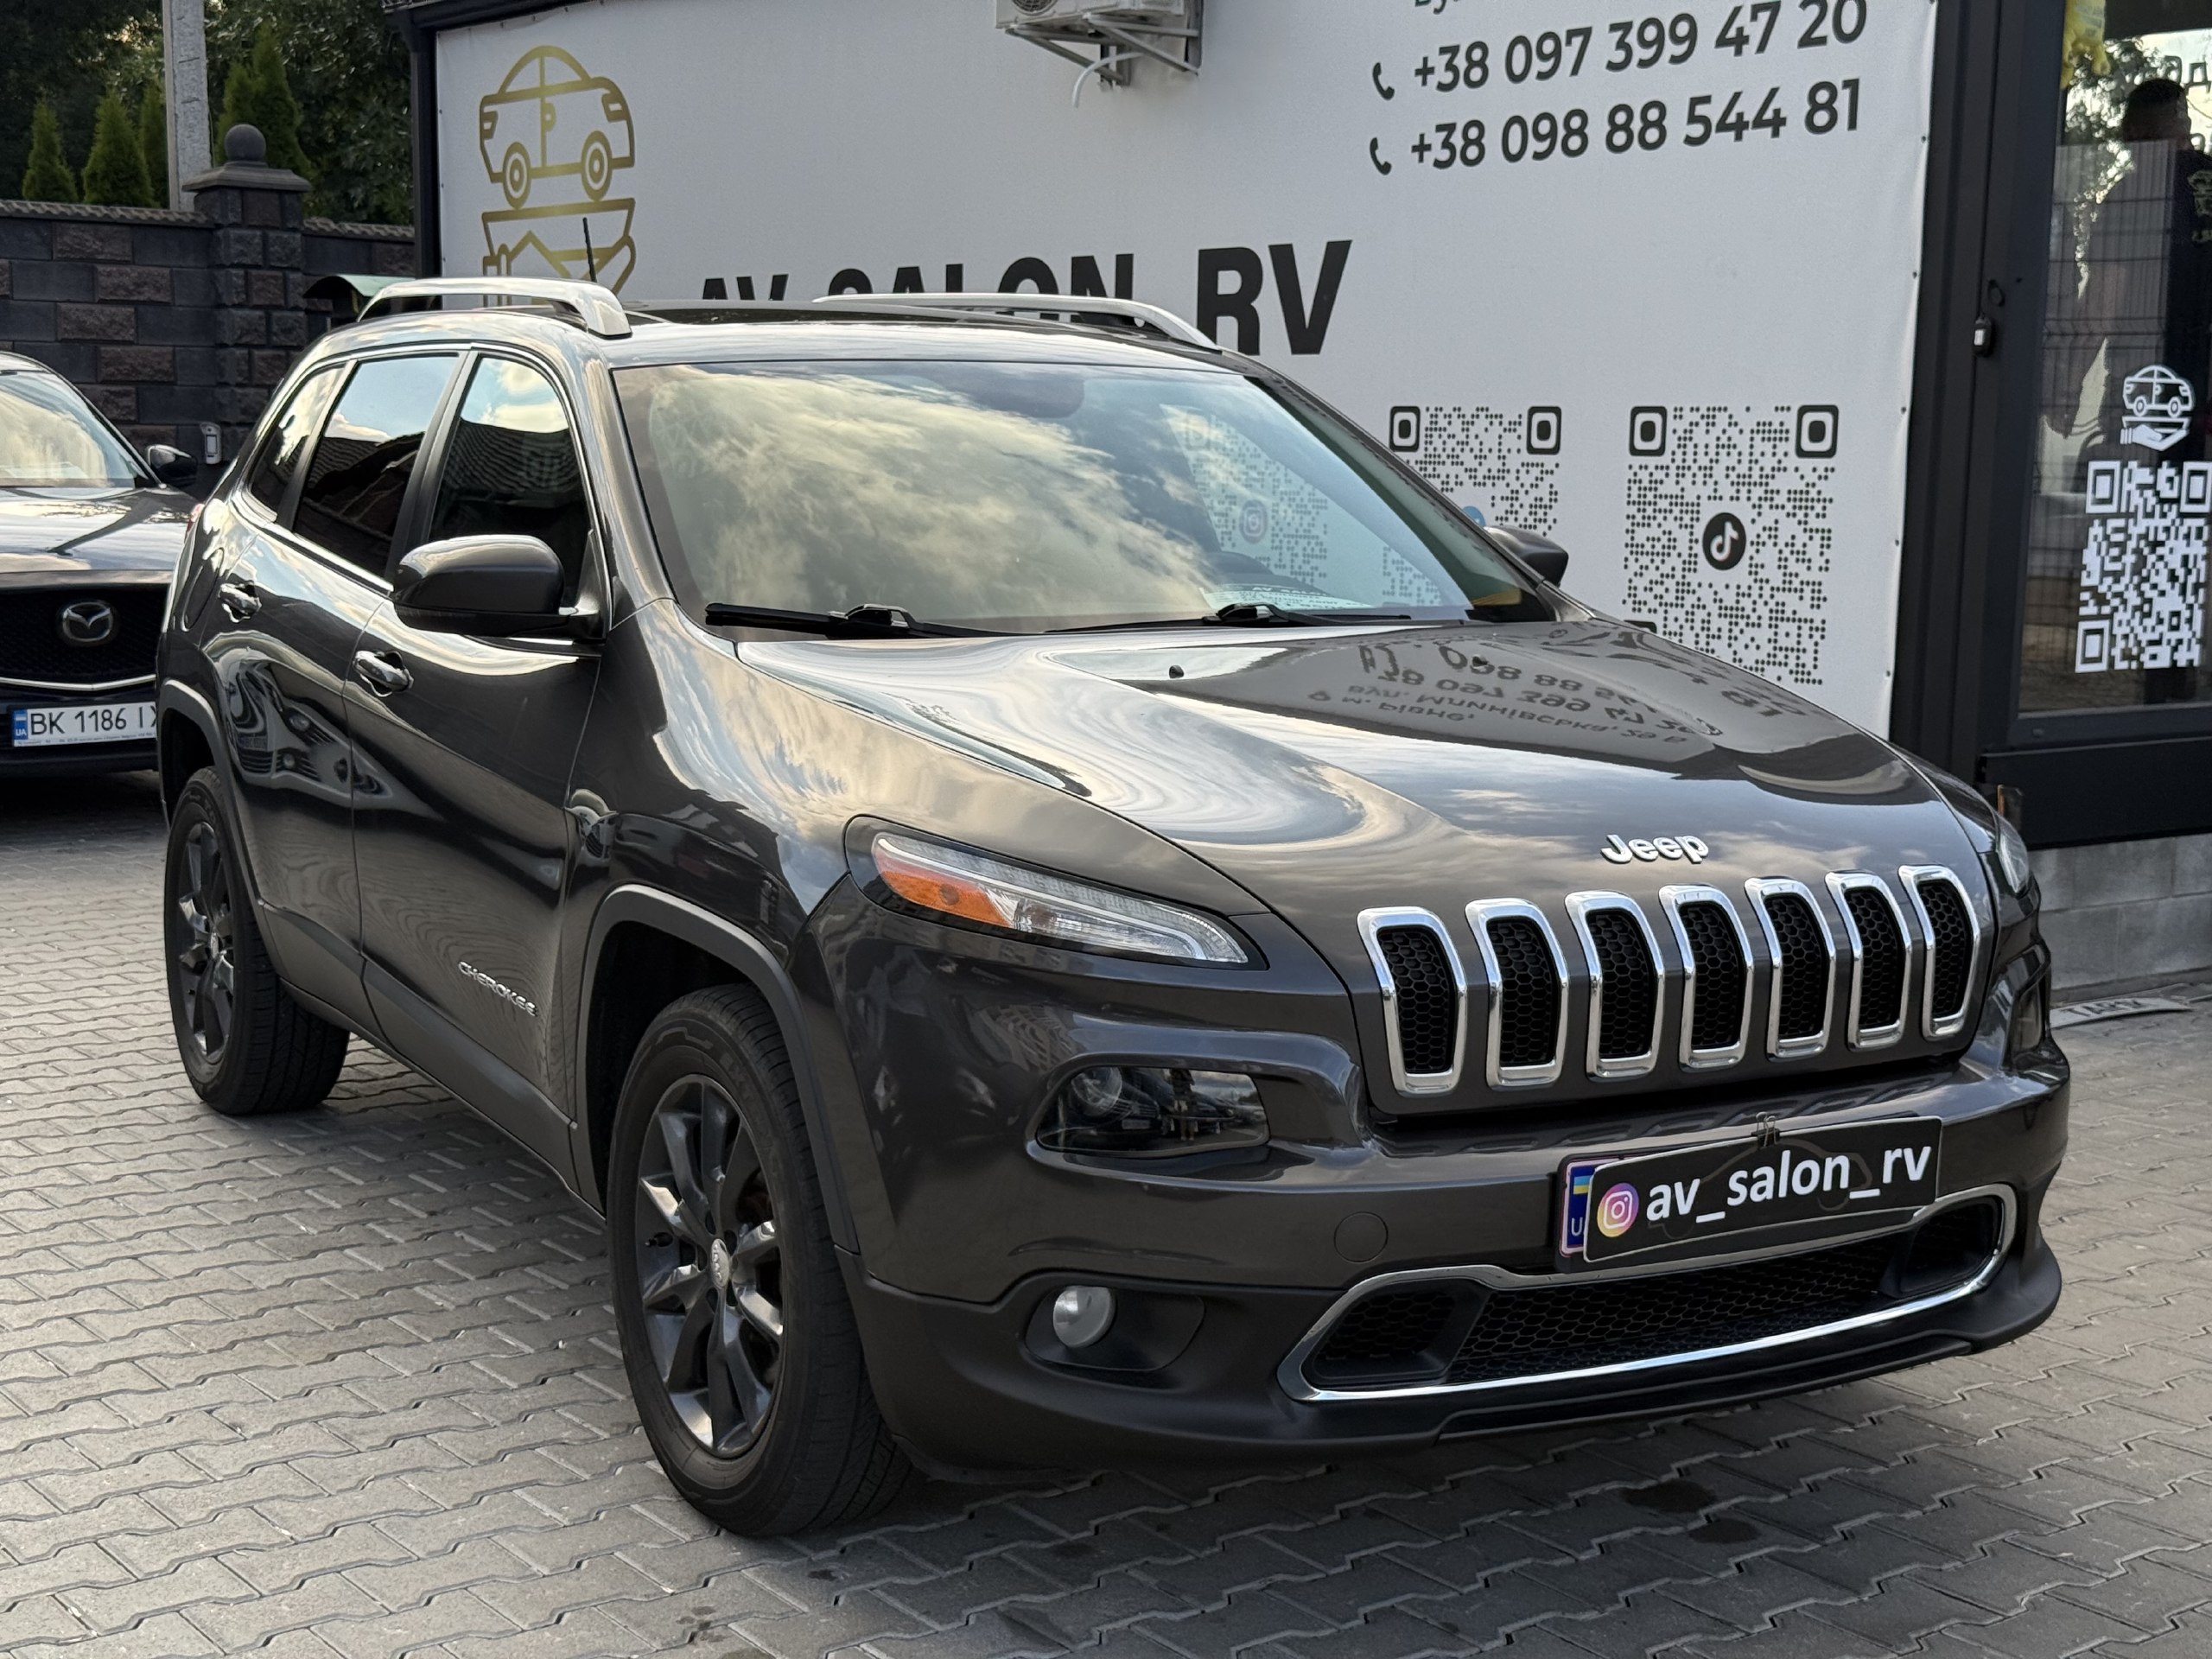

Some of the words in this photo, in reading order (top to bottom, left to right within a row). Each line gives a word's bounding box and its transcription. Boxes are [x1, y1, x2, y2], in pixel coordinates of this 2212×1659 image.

[1414, 41, 1489, 92] +38
[1504, 26, 1592, 84] 097
[1605, 13, 1698, 72] 399
[1714, 0, 1782, 57] 47
[1797, 0, 1867, 48] 20
[1411, 119, 1486, 170] +38
[1501, 108, 1589, 163] 098
[1605, 100, 1668, 154] 88
[1683, 86, 1787, 147] 544
[1804, 78, 1859, 135] 81
[1197, 239, 1352, 356] RV
[16, 728, 27, 737] UA
[30, 711, 65, 735] BK
[74, 707, 127, 733] 1186
[1600, 834, 1709, 864] Jeep
[1647, 1146, 1932, 1224] av_salon_rv
[1571, 1217, 1584, 1237] U
